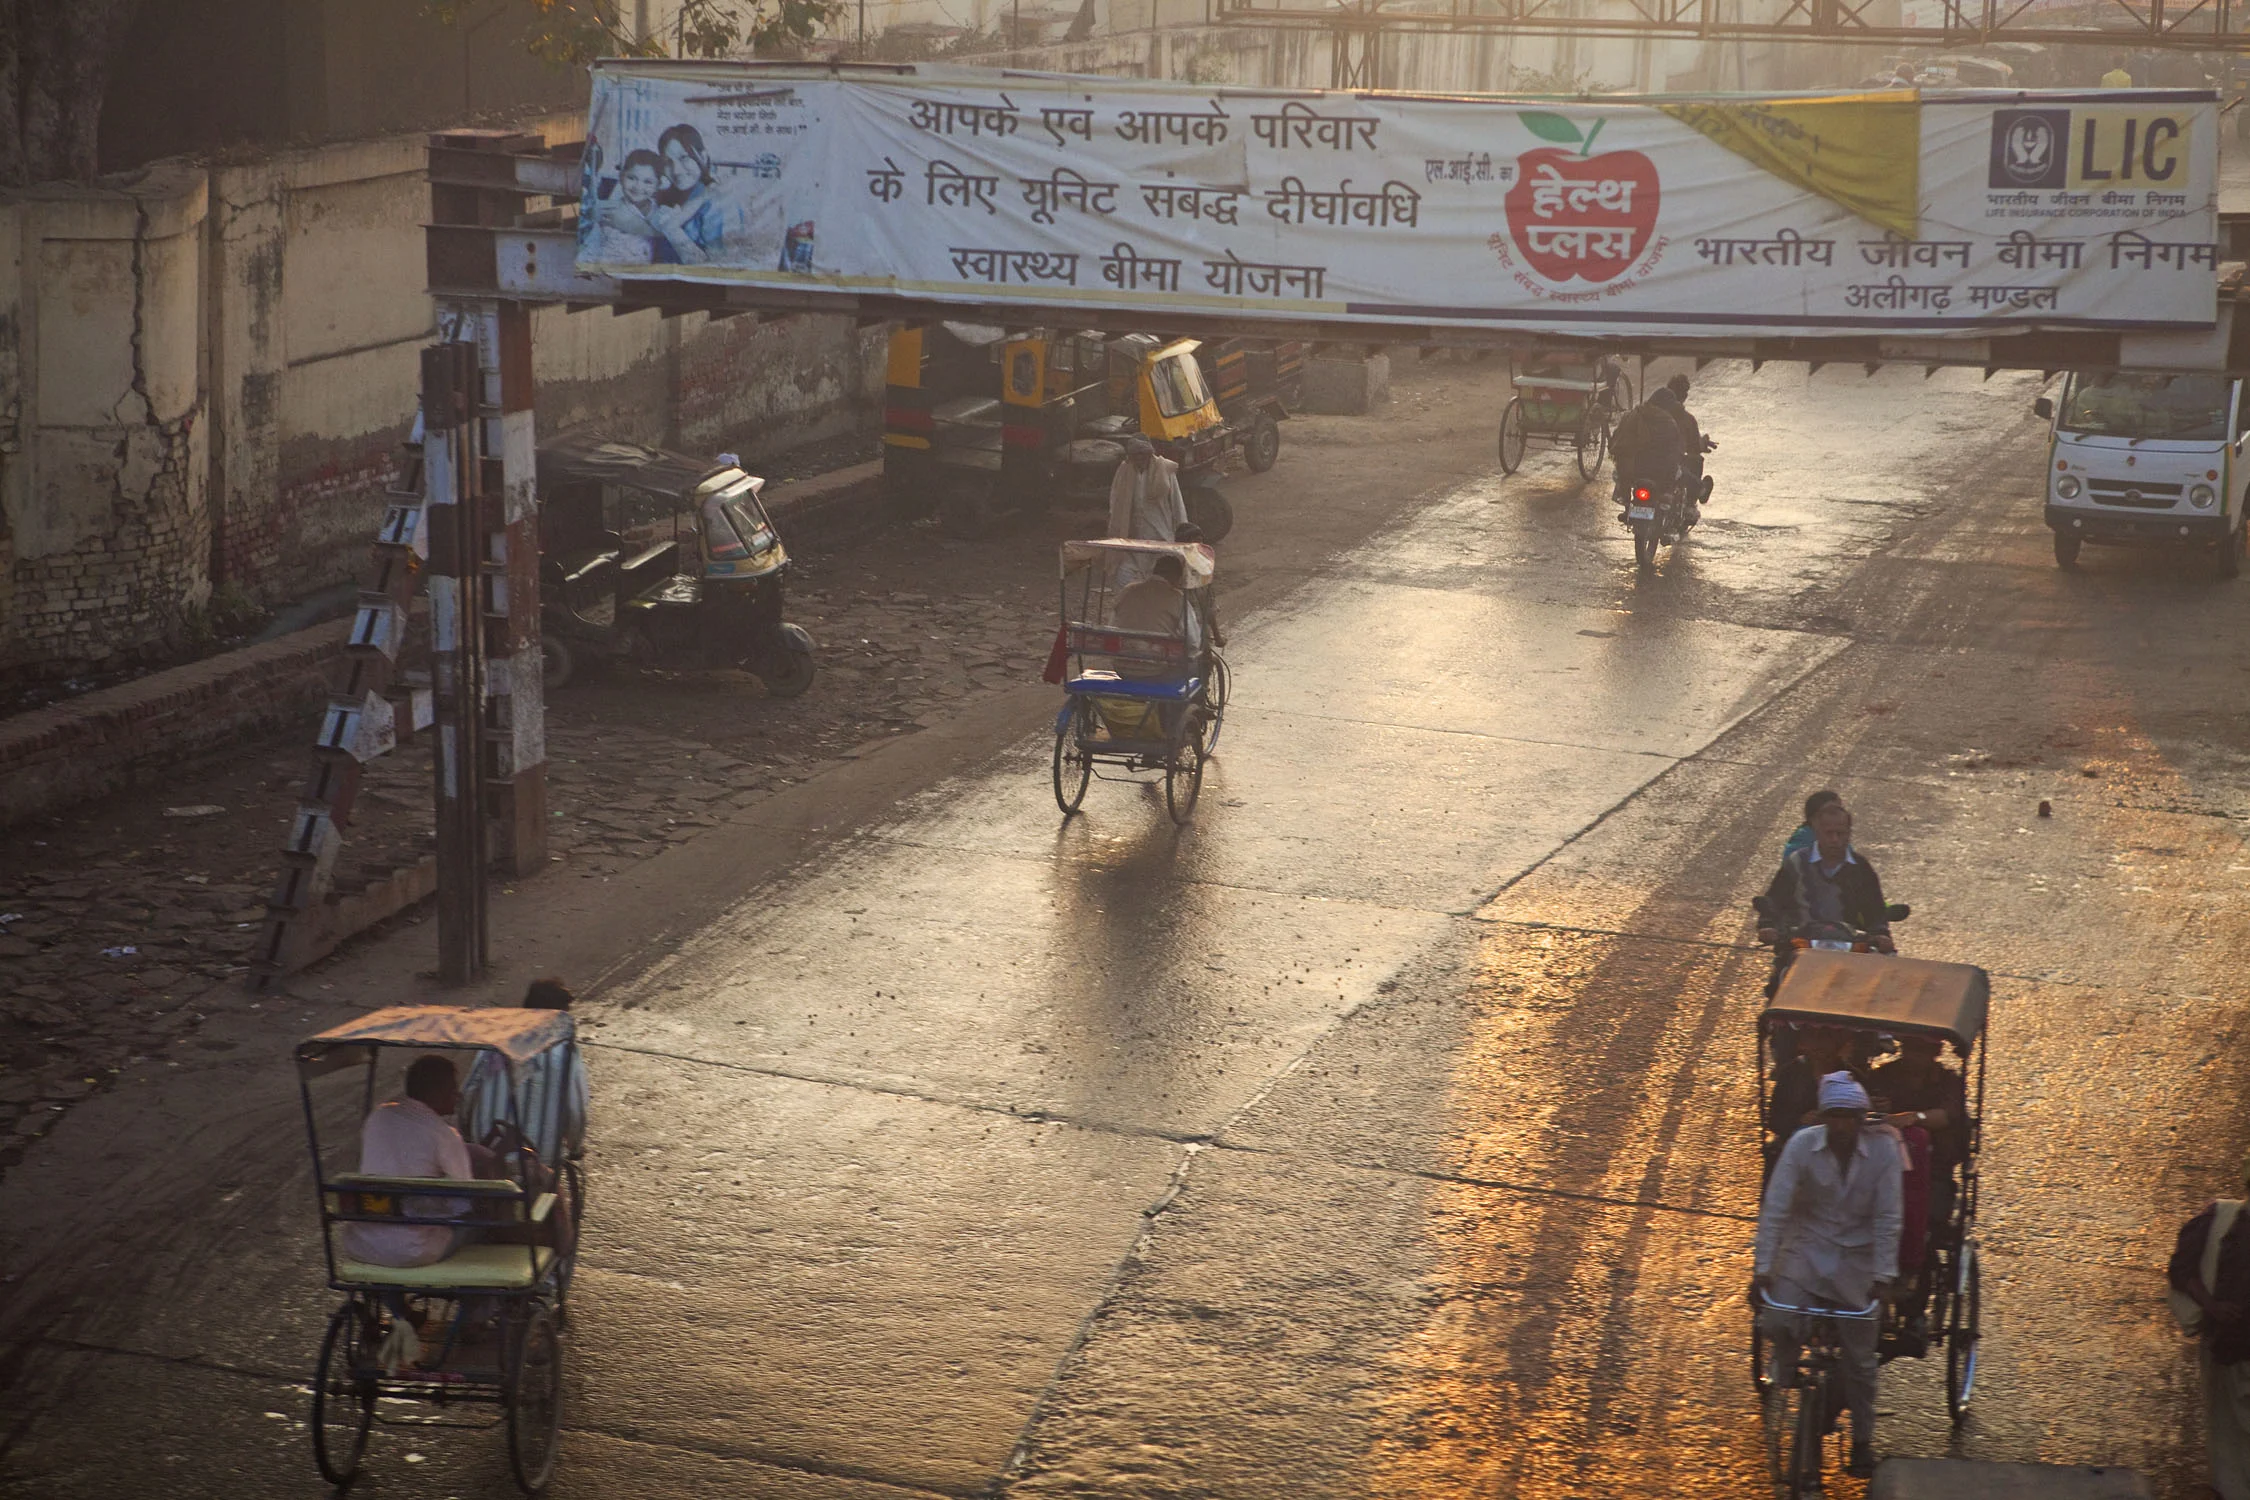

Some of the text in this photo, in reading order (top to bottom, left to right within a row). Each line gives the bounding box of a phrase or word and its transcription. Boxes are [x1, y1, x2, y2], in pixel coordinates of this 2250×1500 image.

[909, 92, 1380, 151] आपके एवं आपके परिवार
[2081, 117, 2178, 181] LIC
[867, 157, 904, 204] के
[925, 160, 997, 214] लिए
[1020, 166, 1119, 224] यूनिट
[1265, 177, 1422, 228] दीर्घावधि
[1499, 165, 1513, 181] का
[1531, 163, 1636, 218] हेल्थ
[1985, 208, 2186, 218] LIFE INSURANCE CORPORATION OF INDIA
[1987, 190, 2186, 206] भारतीय जीवन बीमा निगम
[1525, 226, 1636, 260] प्लस
[1694, 228, 2218, 273] भारतीय जीवन बीमा निगम
[950, 242, 1326, 299] स्वास्थ्य बीमा योजना
[1844, 275, 2058, 314] अलीगढ़ मण्डल
